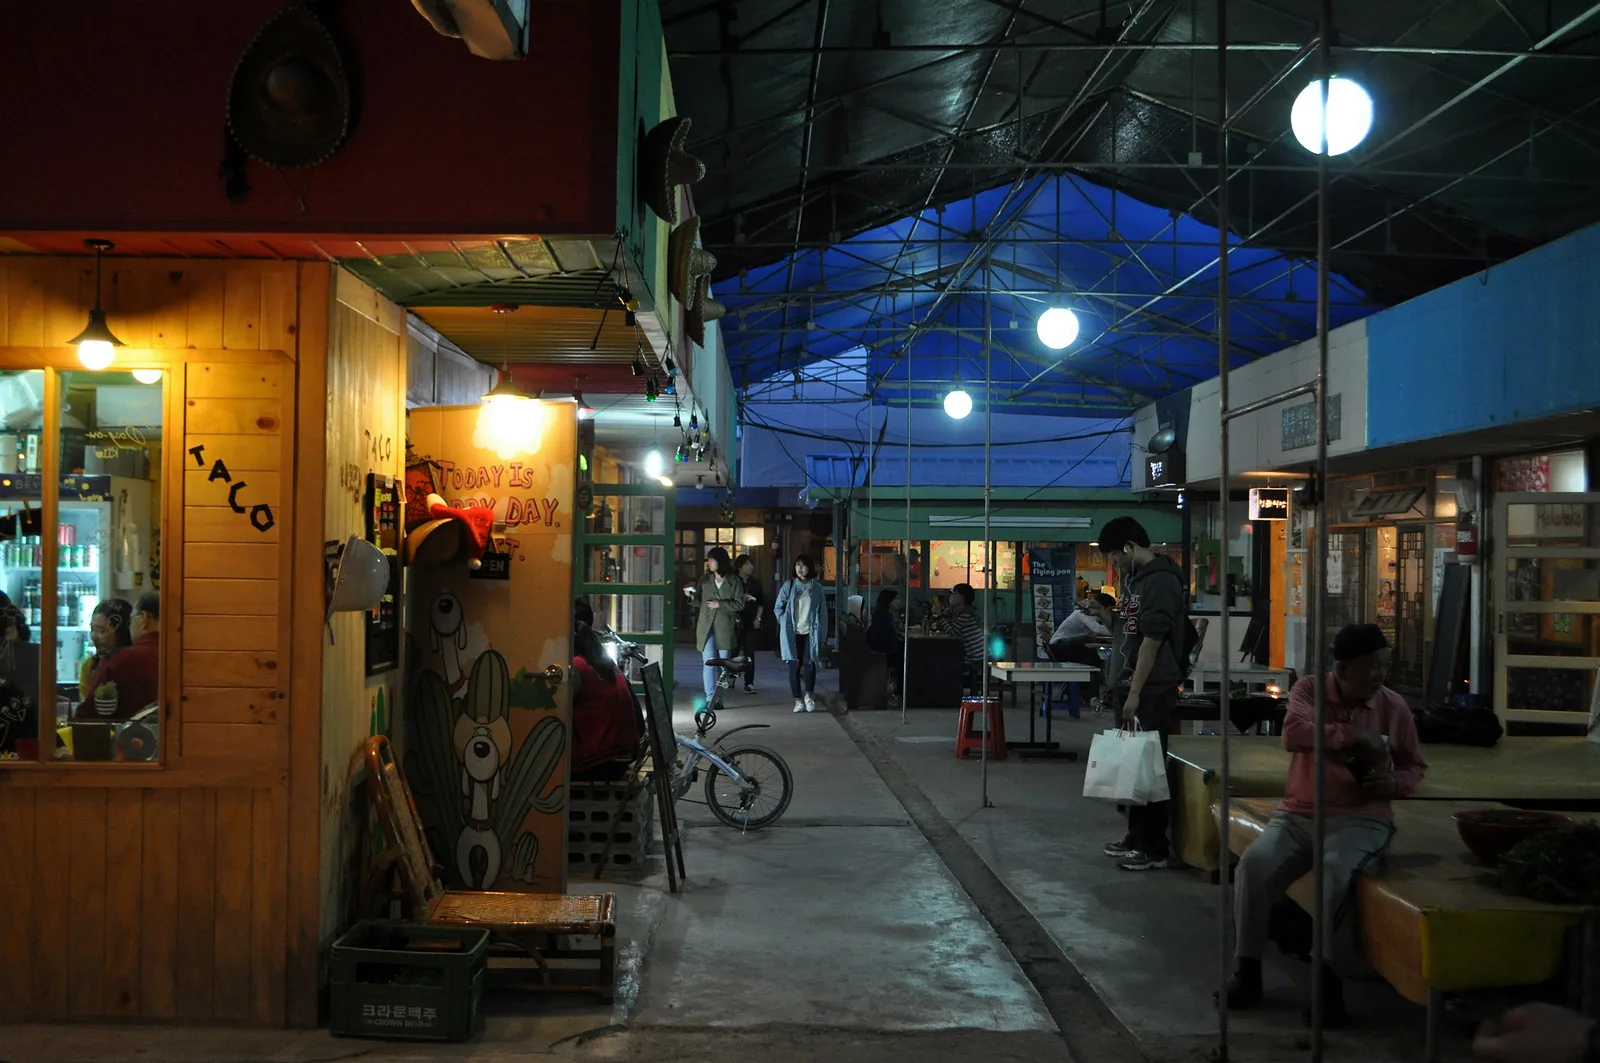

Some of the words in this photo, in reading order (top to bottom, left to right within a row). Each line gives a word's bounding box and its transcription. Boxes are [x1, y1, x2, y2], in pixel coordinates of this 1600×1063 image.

[437, 460, 504, 490] TODAY
[189, 445, 275, 532] TACO
[505, 496, 560, 528] DAY.
[1032, 560, 1046, 568] The
[361, 1004, 437, 1020] 크라운맥주
[374, 1018, 403, 1028] CROWN
